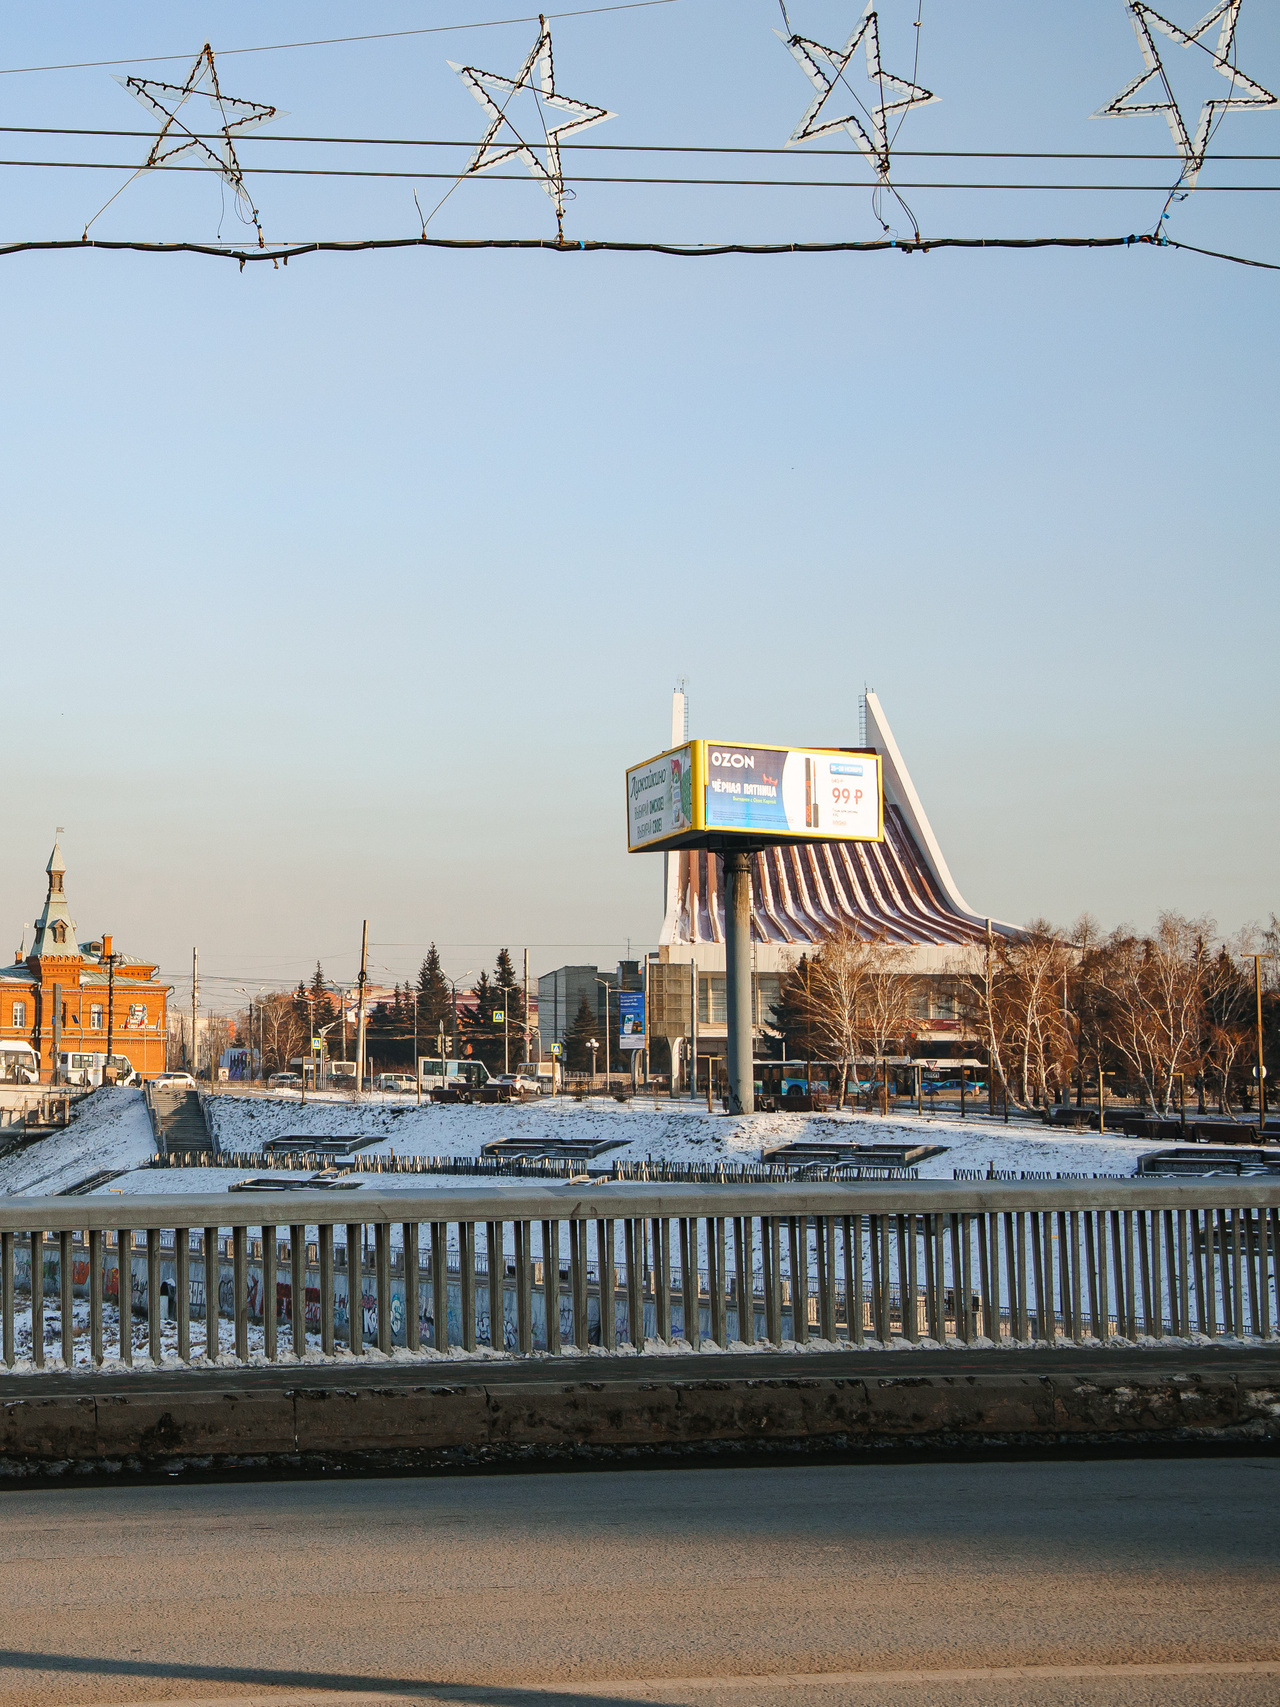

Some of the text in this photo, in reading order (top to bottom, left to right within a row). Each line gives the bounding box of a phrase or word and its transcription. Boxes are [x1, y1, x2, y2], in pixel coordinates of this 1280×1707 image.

[711, 751, 755, 769] OZON
[630, 768, 667, 801] Лужайкино
[711, 778, 777, 798] ЧЁРНАЯ ПЯТНИЦА
[832, 787, 851, 805] 99
